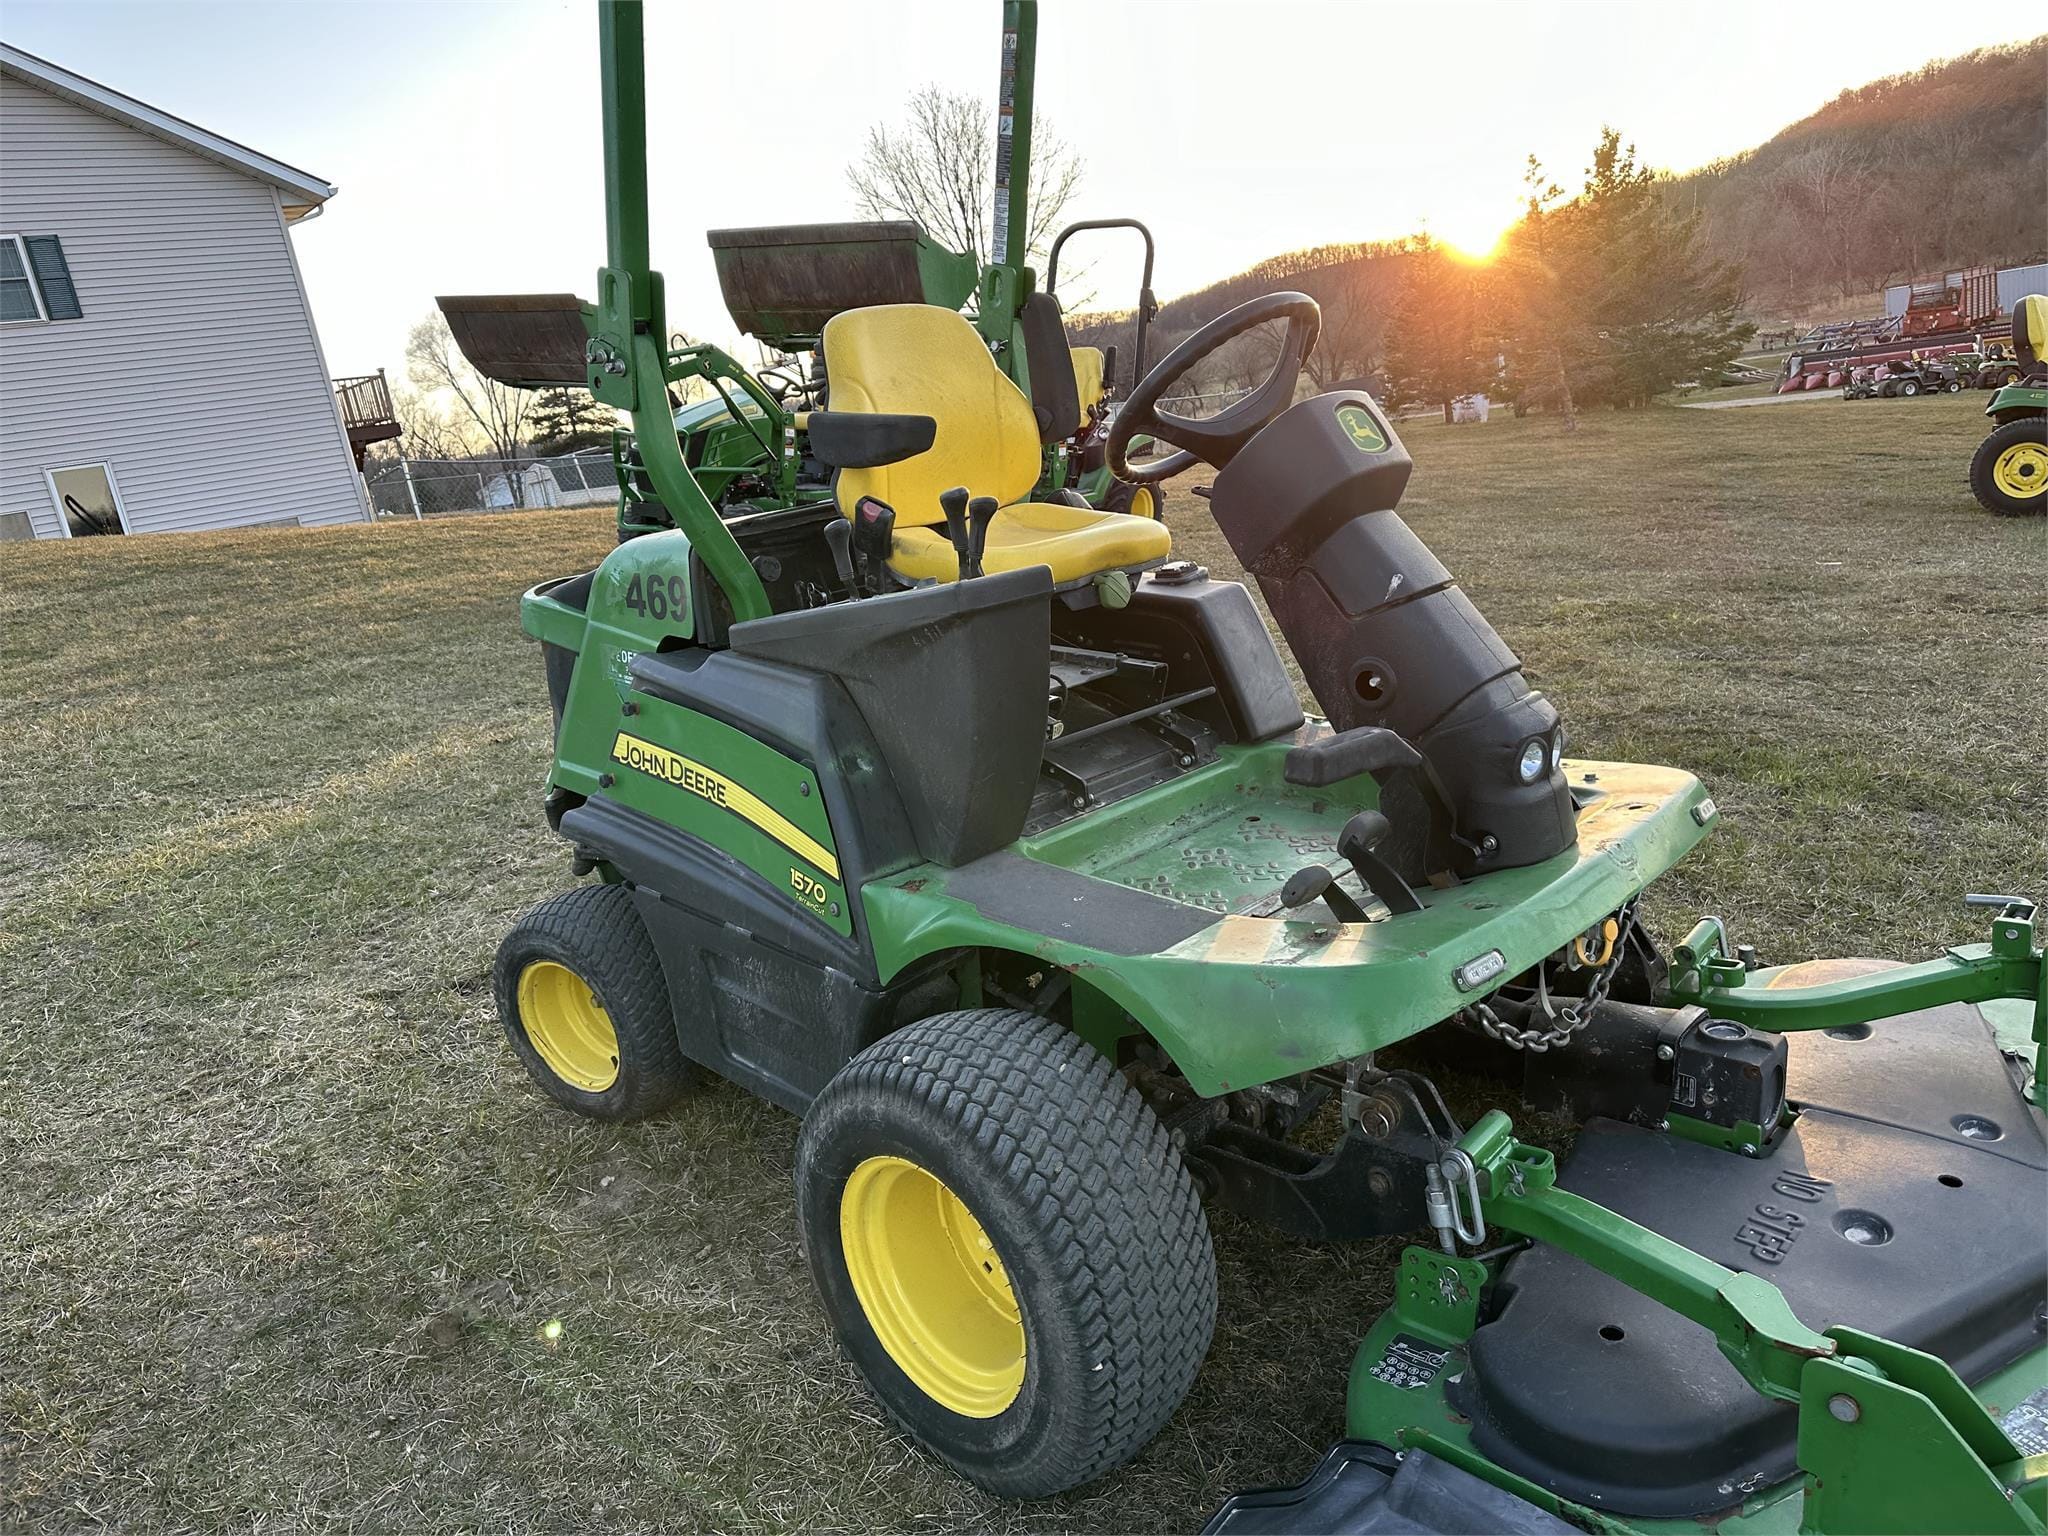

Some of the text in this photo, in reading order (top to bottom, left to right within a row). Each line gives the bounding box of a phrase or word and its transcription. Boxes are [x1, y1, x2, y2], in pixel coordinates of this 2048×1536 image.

[626, 573, 688, 622] 469
[620, 740, 727, 805] JOHN DEERE
[790, 867, 826, 903] 1570
[1734, 1169, 1833, 1265] NO STEP
